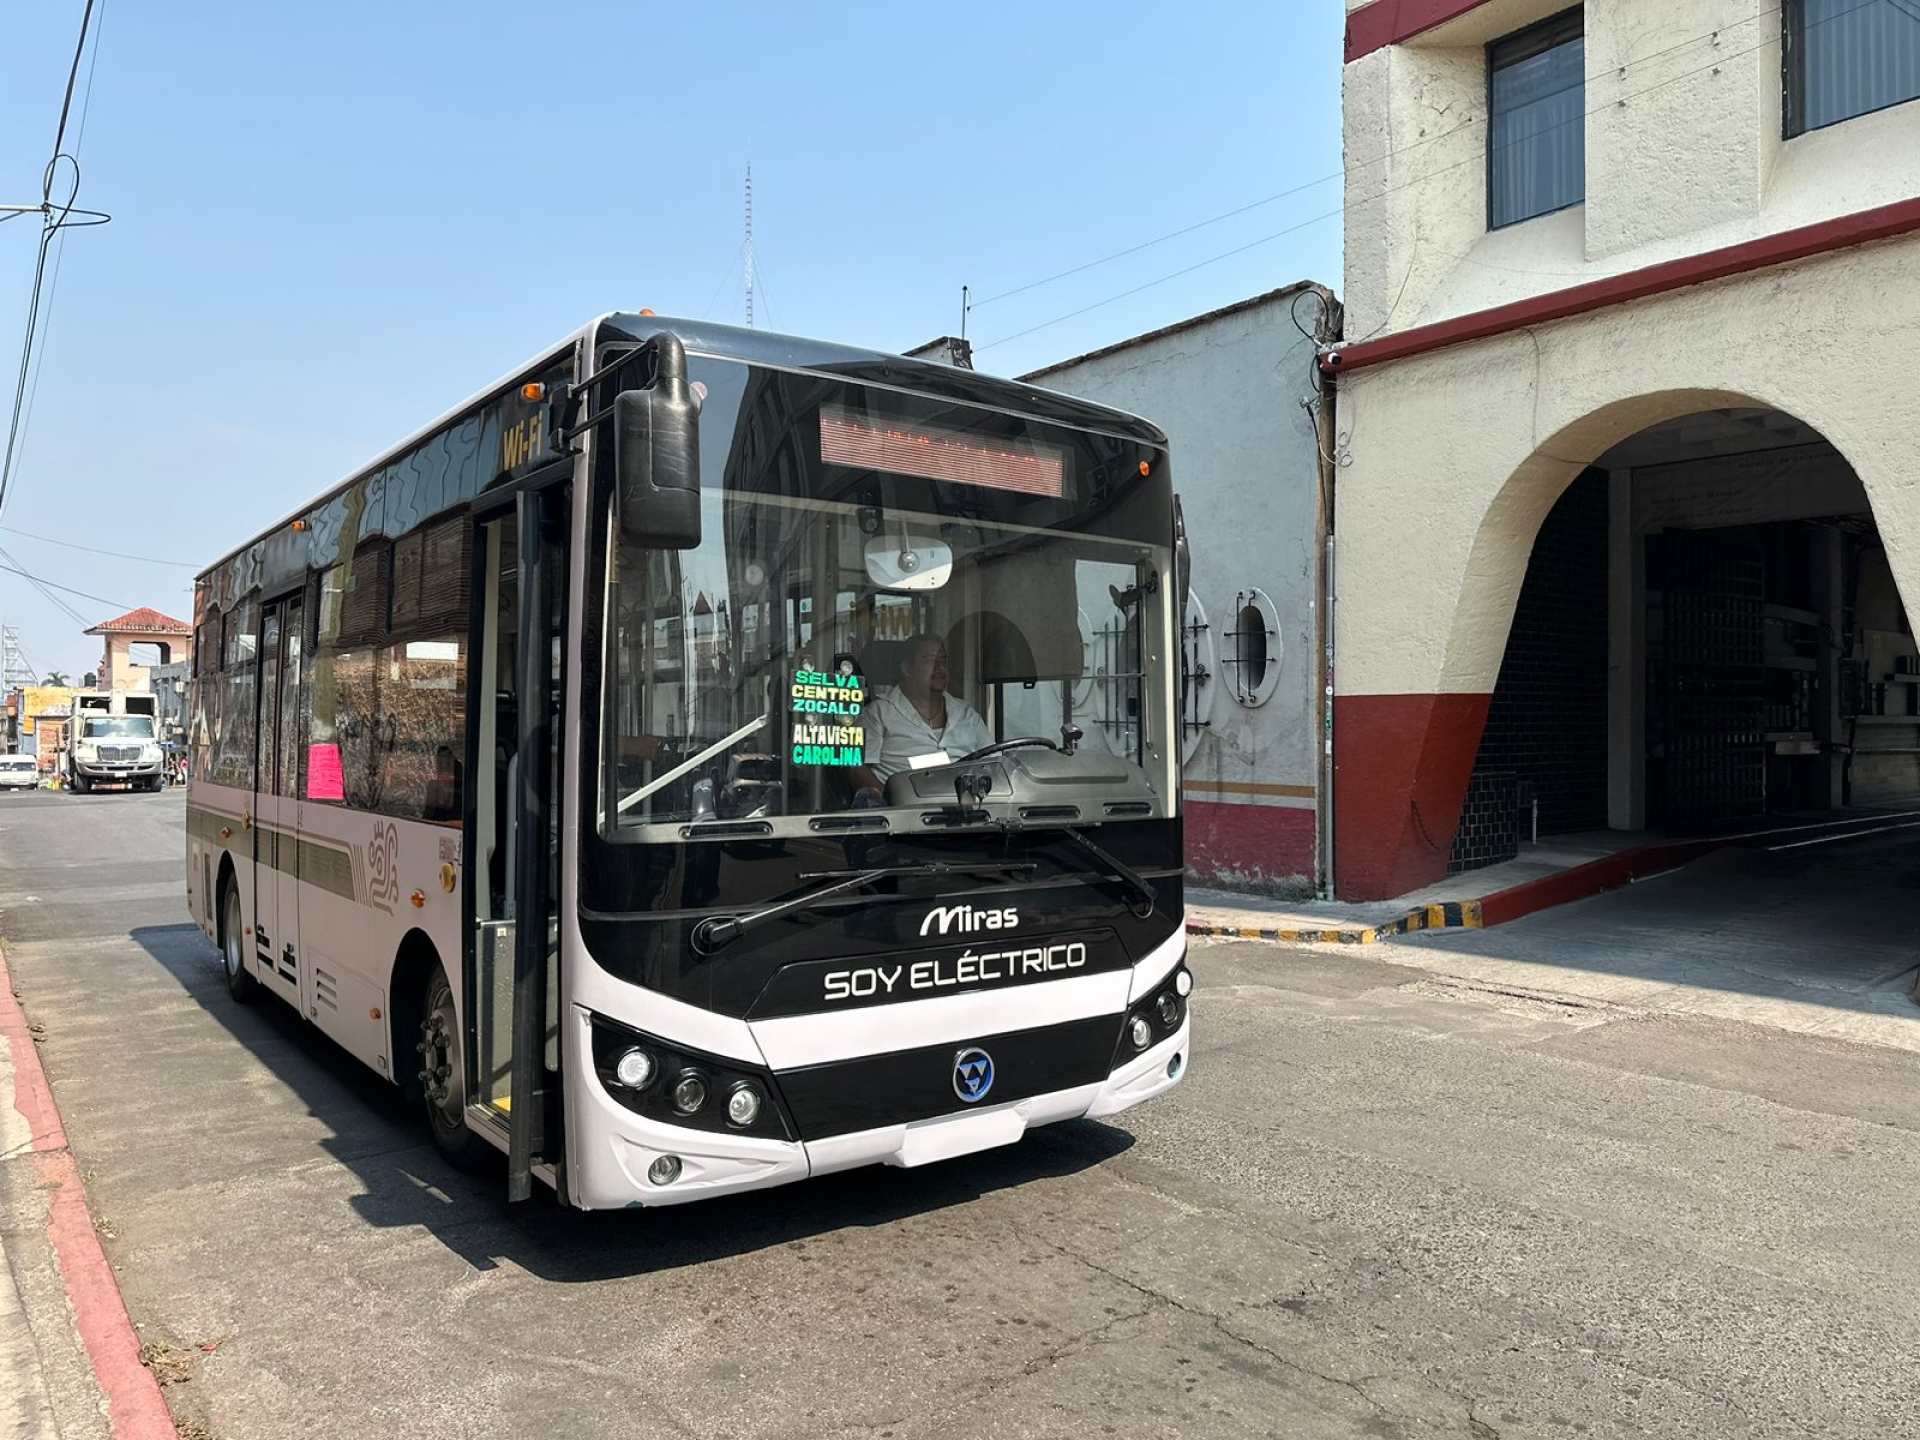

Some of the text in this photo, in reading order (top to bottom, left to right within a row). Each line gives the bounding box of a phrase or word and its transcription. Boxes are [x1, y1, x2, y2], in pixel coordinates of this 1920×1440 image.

[504, 409, 543, 471] Wi-Fi
[796, 670, 859, 688] SELVA
[791, 685, 863, 702] CENTRO
[793, 699, 860, 715] ZOCALO
[919, 905, 1019, 936] Miras
[824, 943, 1086, 1000] SOY ELÉCTRICO
